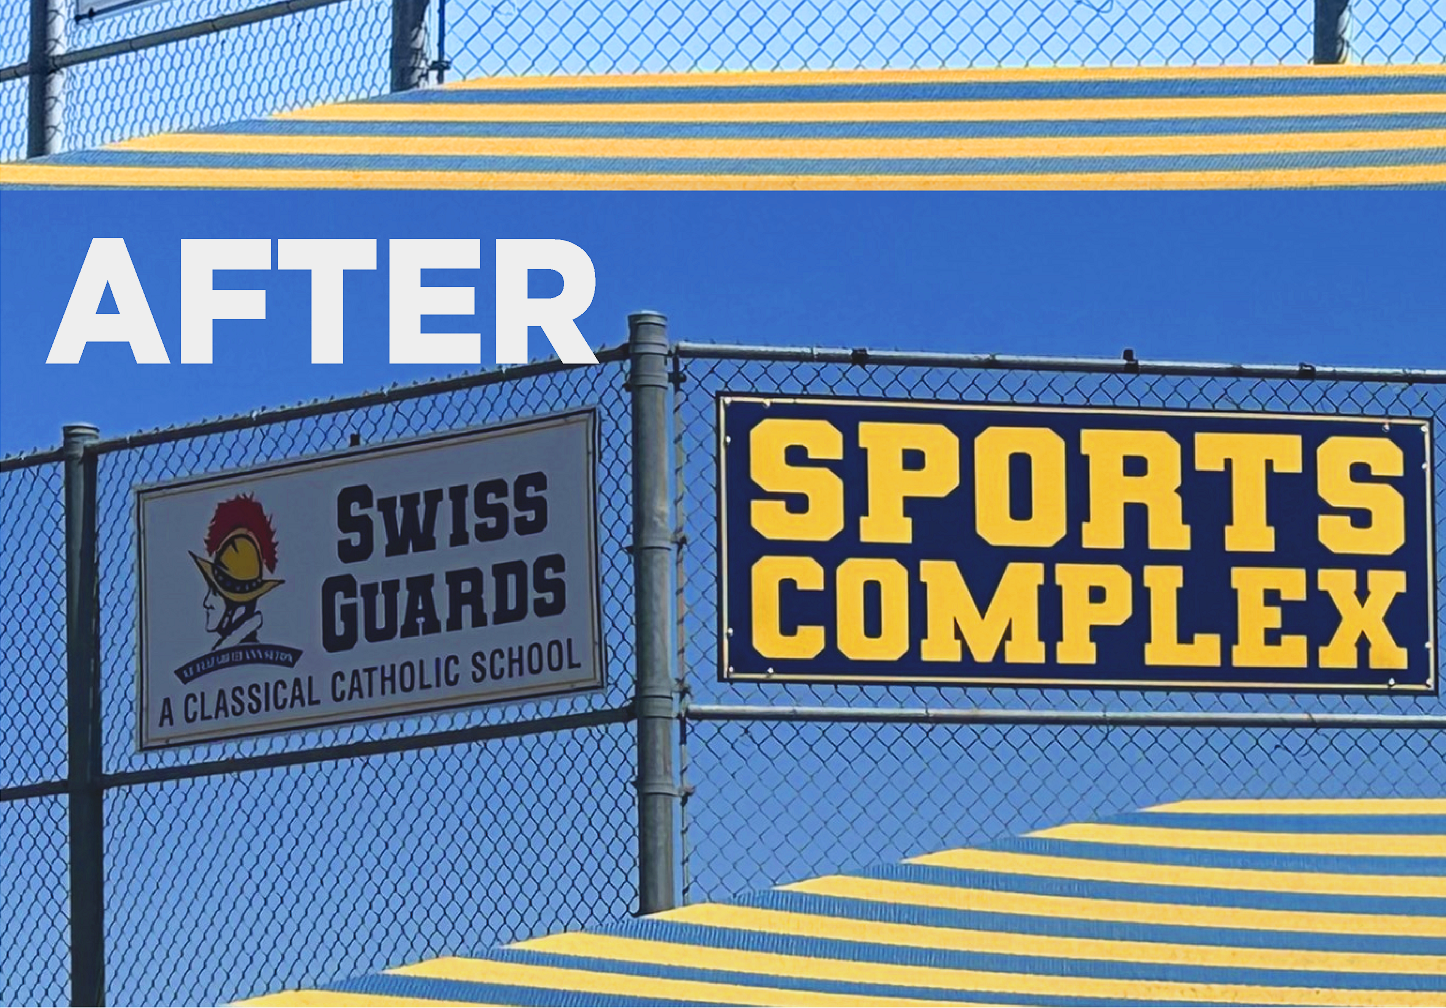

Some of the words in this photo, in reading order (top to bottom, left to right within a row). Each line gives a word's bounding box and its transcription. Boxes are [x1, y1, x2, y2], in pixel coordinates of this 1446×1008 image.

[336, 471, 548, 564] SWISS
[750, 418, 1406, 555] SPORTS
[321, 553, 566, 653] GUARDS
[750, 555, 1408, 669] COMPLEX
[158, 697, 174, 728] A
[184, 675, 321, 723] CLASSICAL
[331, 655, 460, 703] CATHOLIC
[471, 638, 581, 684] SCHOOL
